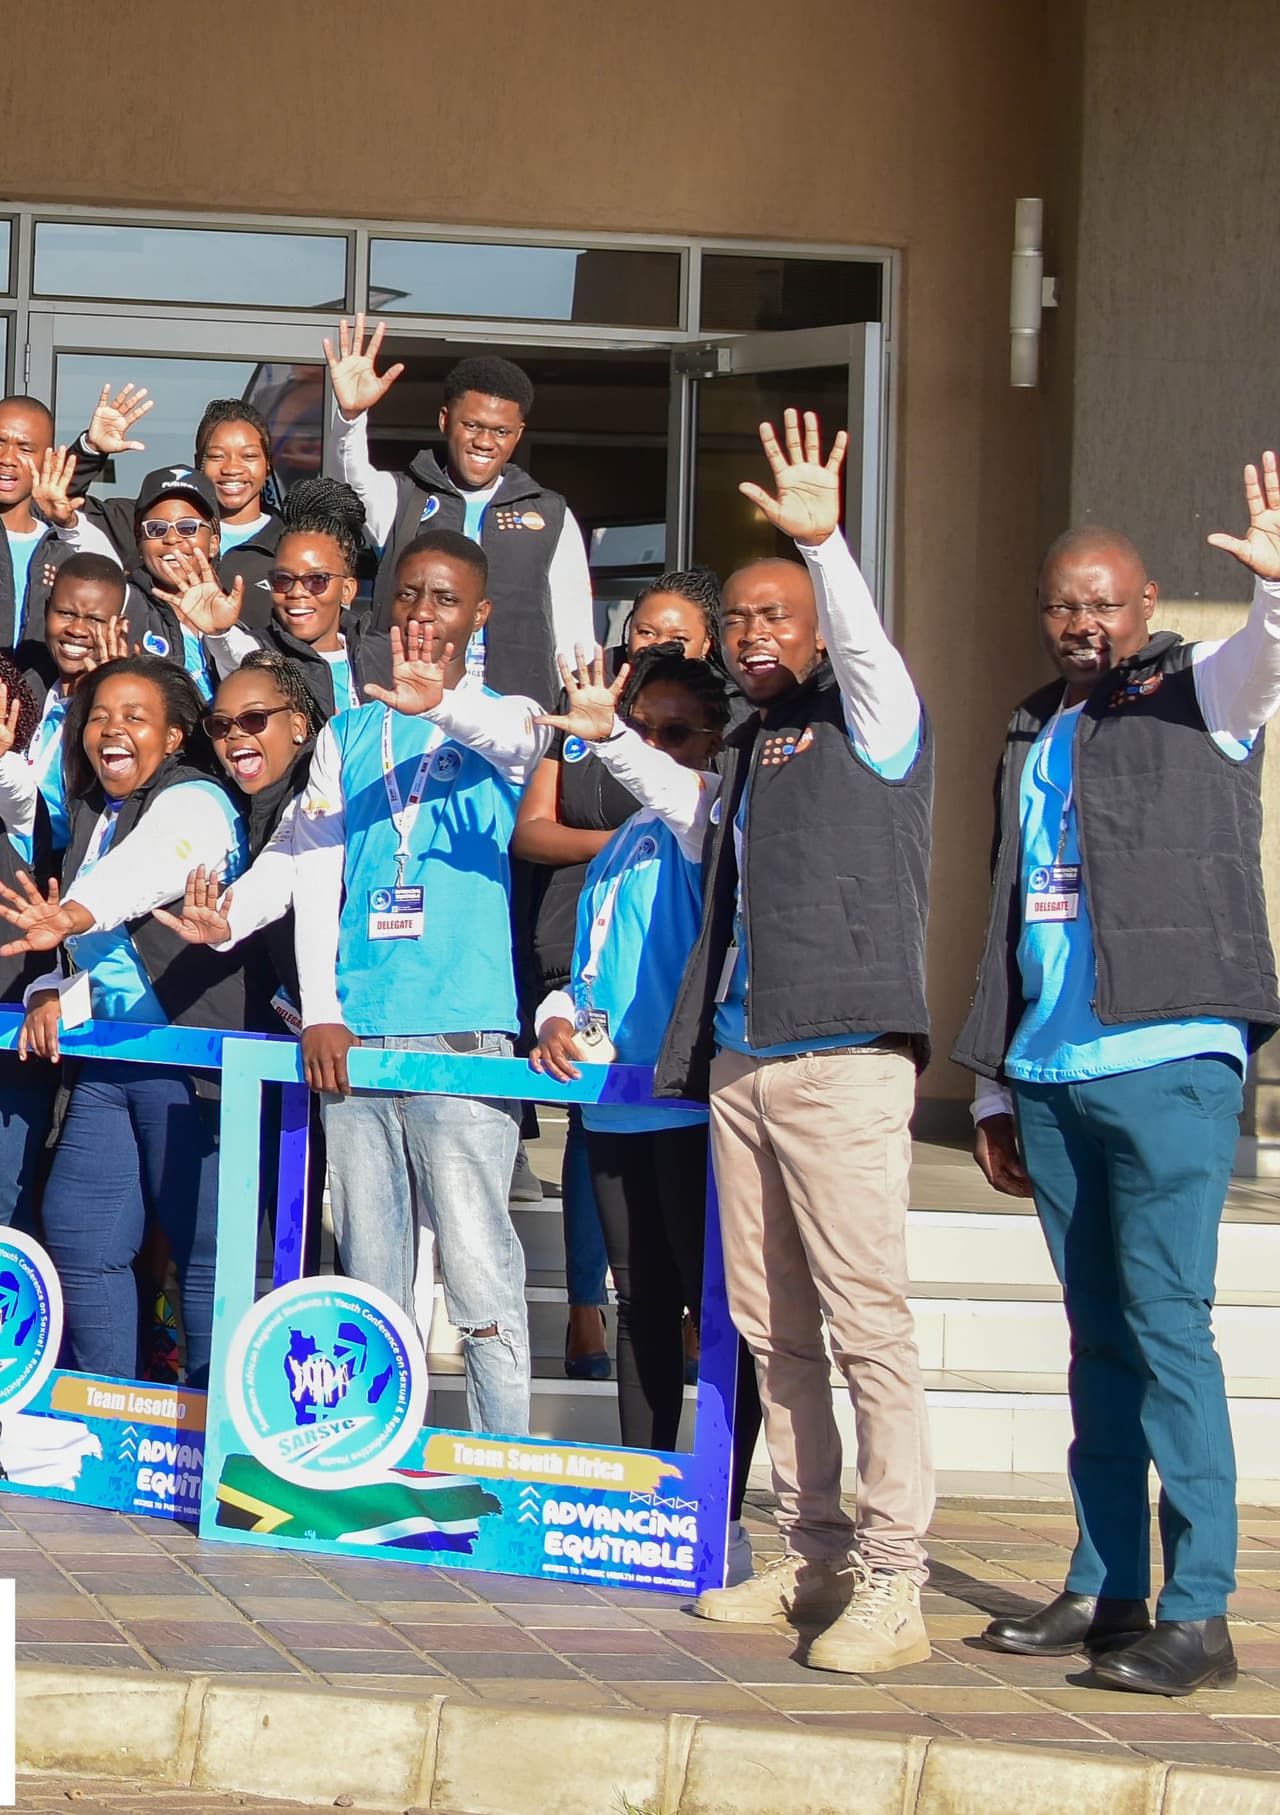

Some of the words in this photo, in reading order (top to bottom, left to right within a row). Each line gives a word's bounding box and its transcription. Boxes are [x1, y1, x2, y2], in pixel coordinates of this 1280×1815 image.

[1034, 900, 1070, 912] DELEGATE
[376, 919, 414, 930] DELEGATE
[0, 1248, 19, 1263] Youth
[18, 1259, 44, 1301] Conference
[39, 1302, 47, 1314] on
[37, 1315, 48, 1349] Sexual
[361, 1308, 400, 1355] Conference
[395, 1355, 405, 1367] on
[86, 1386, 126, 1411] Team
[127, 1392, 186, 1419] Lesotho
[398, 1368, 408, 1406] Sexual
[137, 1438, 203, 1470] ADVAN
[278, 1419, 356, 1457] SARSYC
[452, 1442, 504, 1467] Team
[507, 1447, 563, 1475] South
[566, 1454, 625, 1482] Africa
